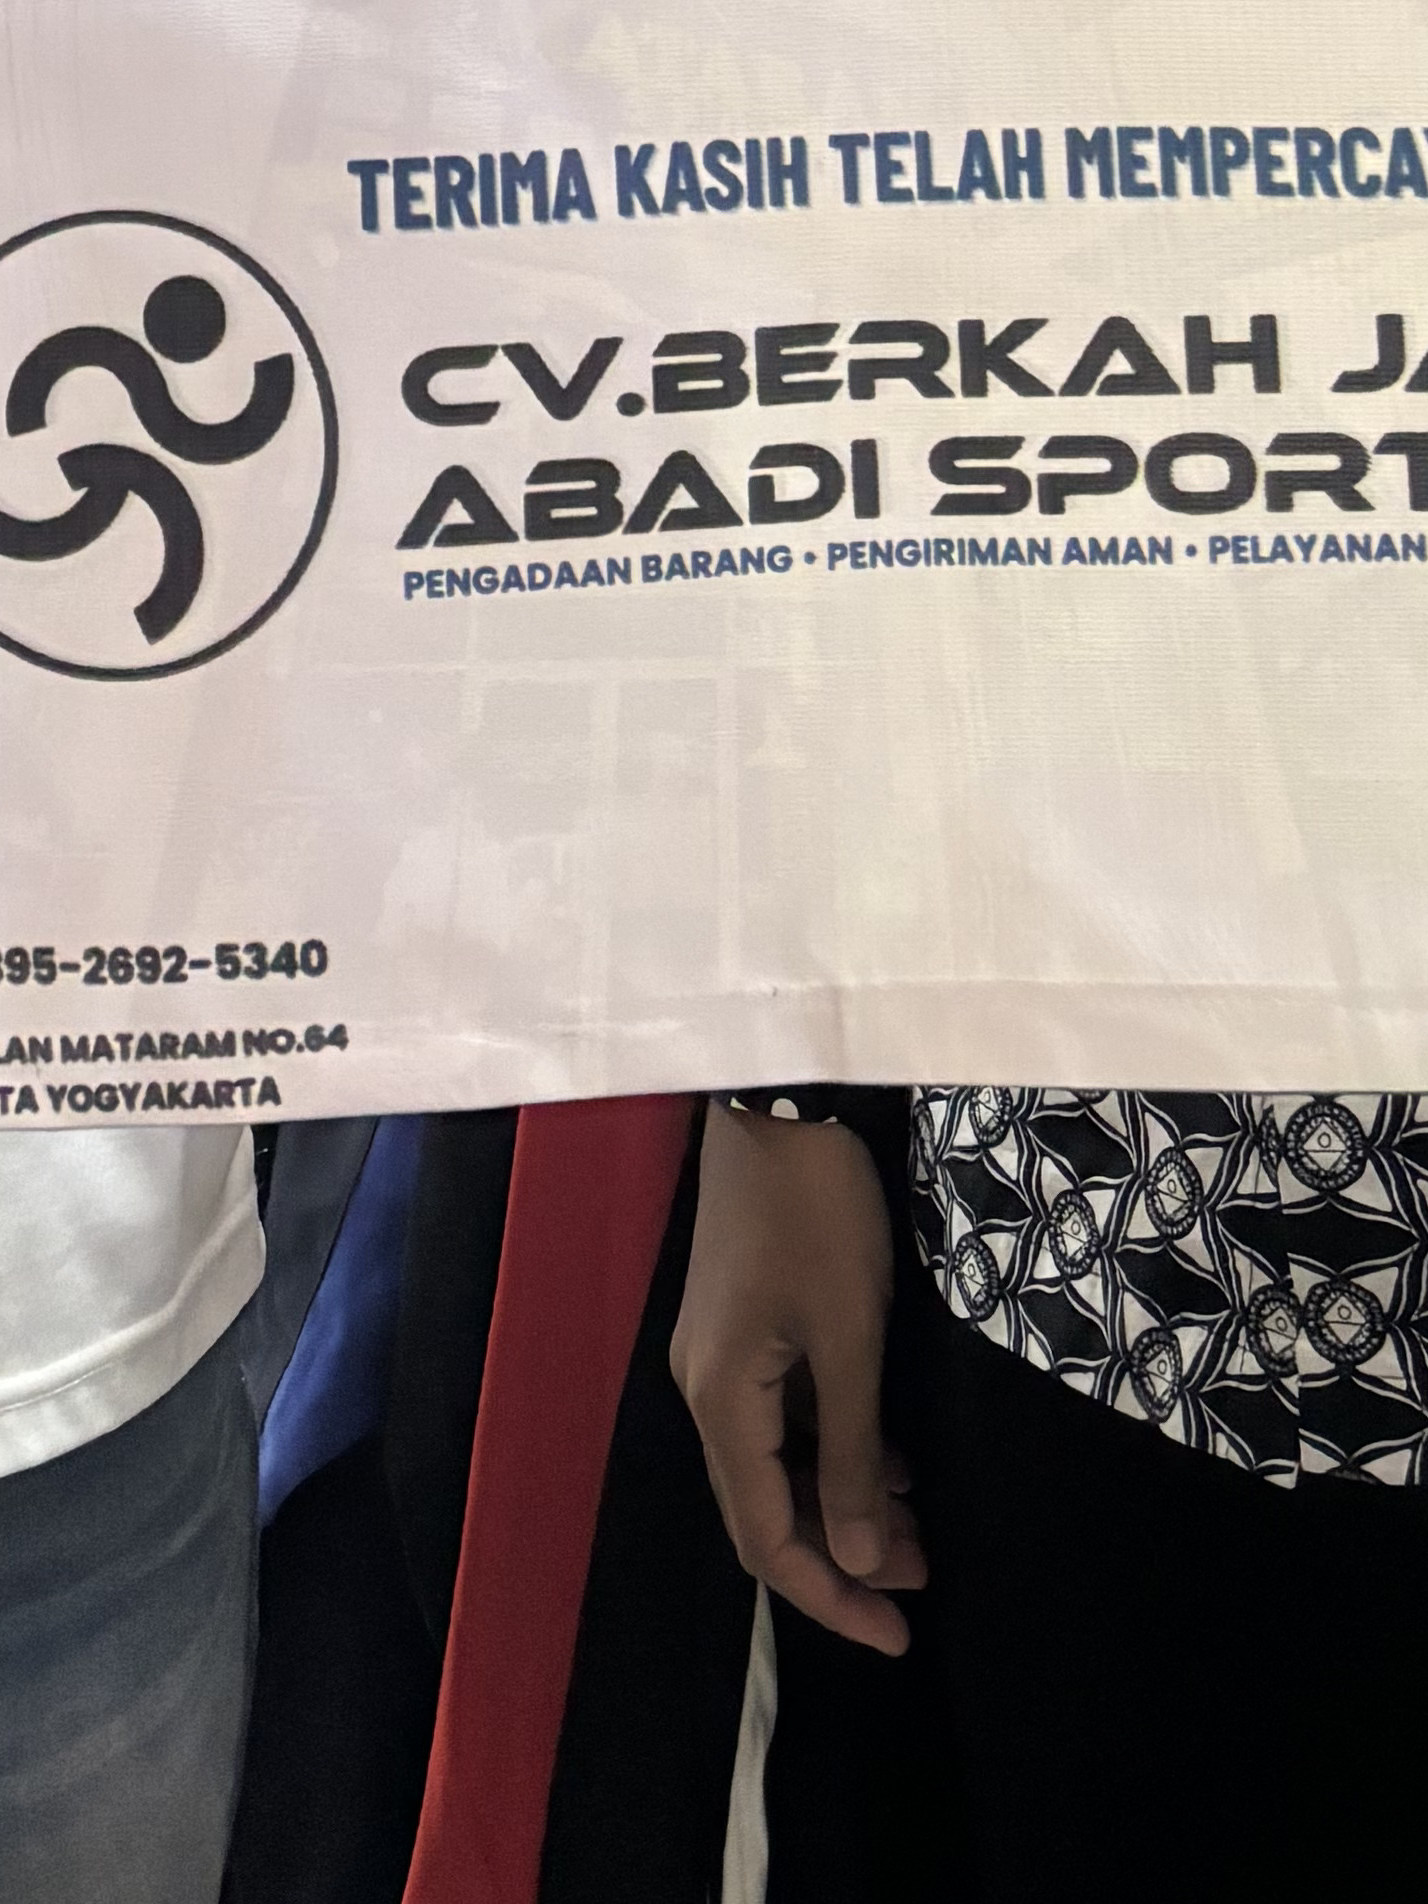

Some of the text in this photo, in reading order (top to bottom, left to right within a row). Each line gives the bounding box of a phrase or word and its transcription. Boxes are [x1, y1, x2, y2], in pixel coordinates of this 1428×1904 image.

[347, 147, 596, 233] TERIMA
[615, 135, 811, 218] KASIH
[828, 128, 1046, 204] TELAH
[400, 313, 1281, 427] CV.BERKAH
[395, 437, 882, 550] ABADI
[402, 556, 632, 601] PENGADAAN
[640, 544, 794, 584] BARANG
[826, 537, 1052, 570] PENGIRIMAN
[1061, 536, 1173, 565] AMAN
[1208, 534, 1428, 564] PELAYANAN
[59, 1030, 236, 1064] MATARAM
[242, 1024, 349, 1058] NO.64
[46, 1076, 282, 1114] YOGYAKARTA
